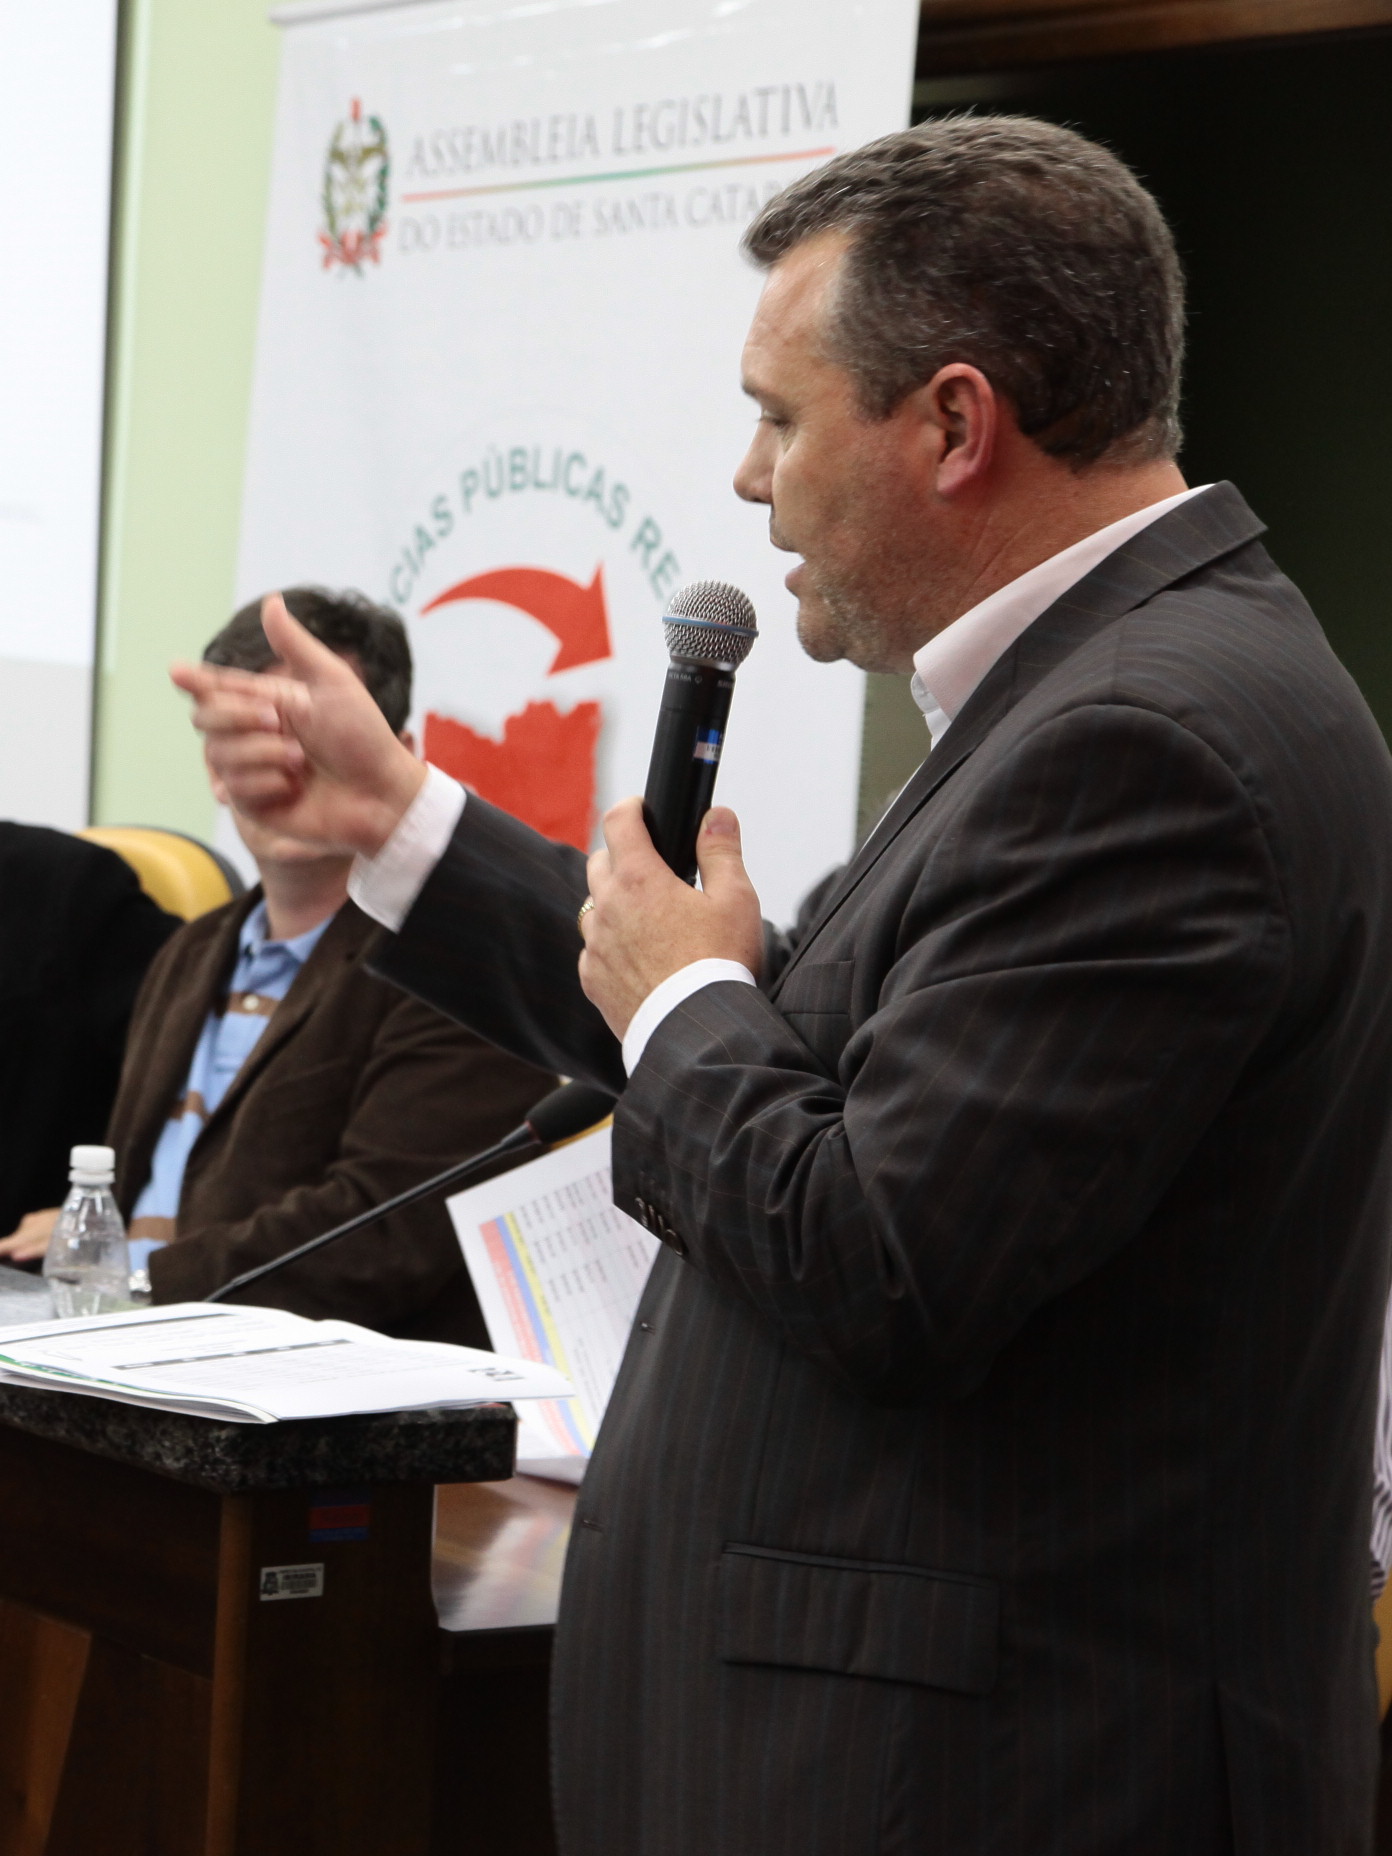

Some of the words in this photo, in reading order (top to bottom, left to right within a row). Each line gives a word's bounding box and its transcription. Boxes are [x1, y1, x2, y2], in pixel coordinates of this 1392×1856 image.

[408, 118, 600, 178] ASSEMBLEIA
[612, 82, 839, 155] LEGISLATIVA
[398, 214, 442, 254] DO
[446, 202, 546, 249] ESTADO
[549, 198, 584, 242] DE
[592, 189, 681, 235] SANTA
[387, 492, 456, 606] CIAS
[460, 443, 631, 530] PÚBLICAS
[629, 514, 682, 602] RE
